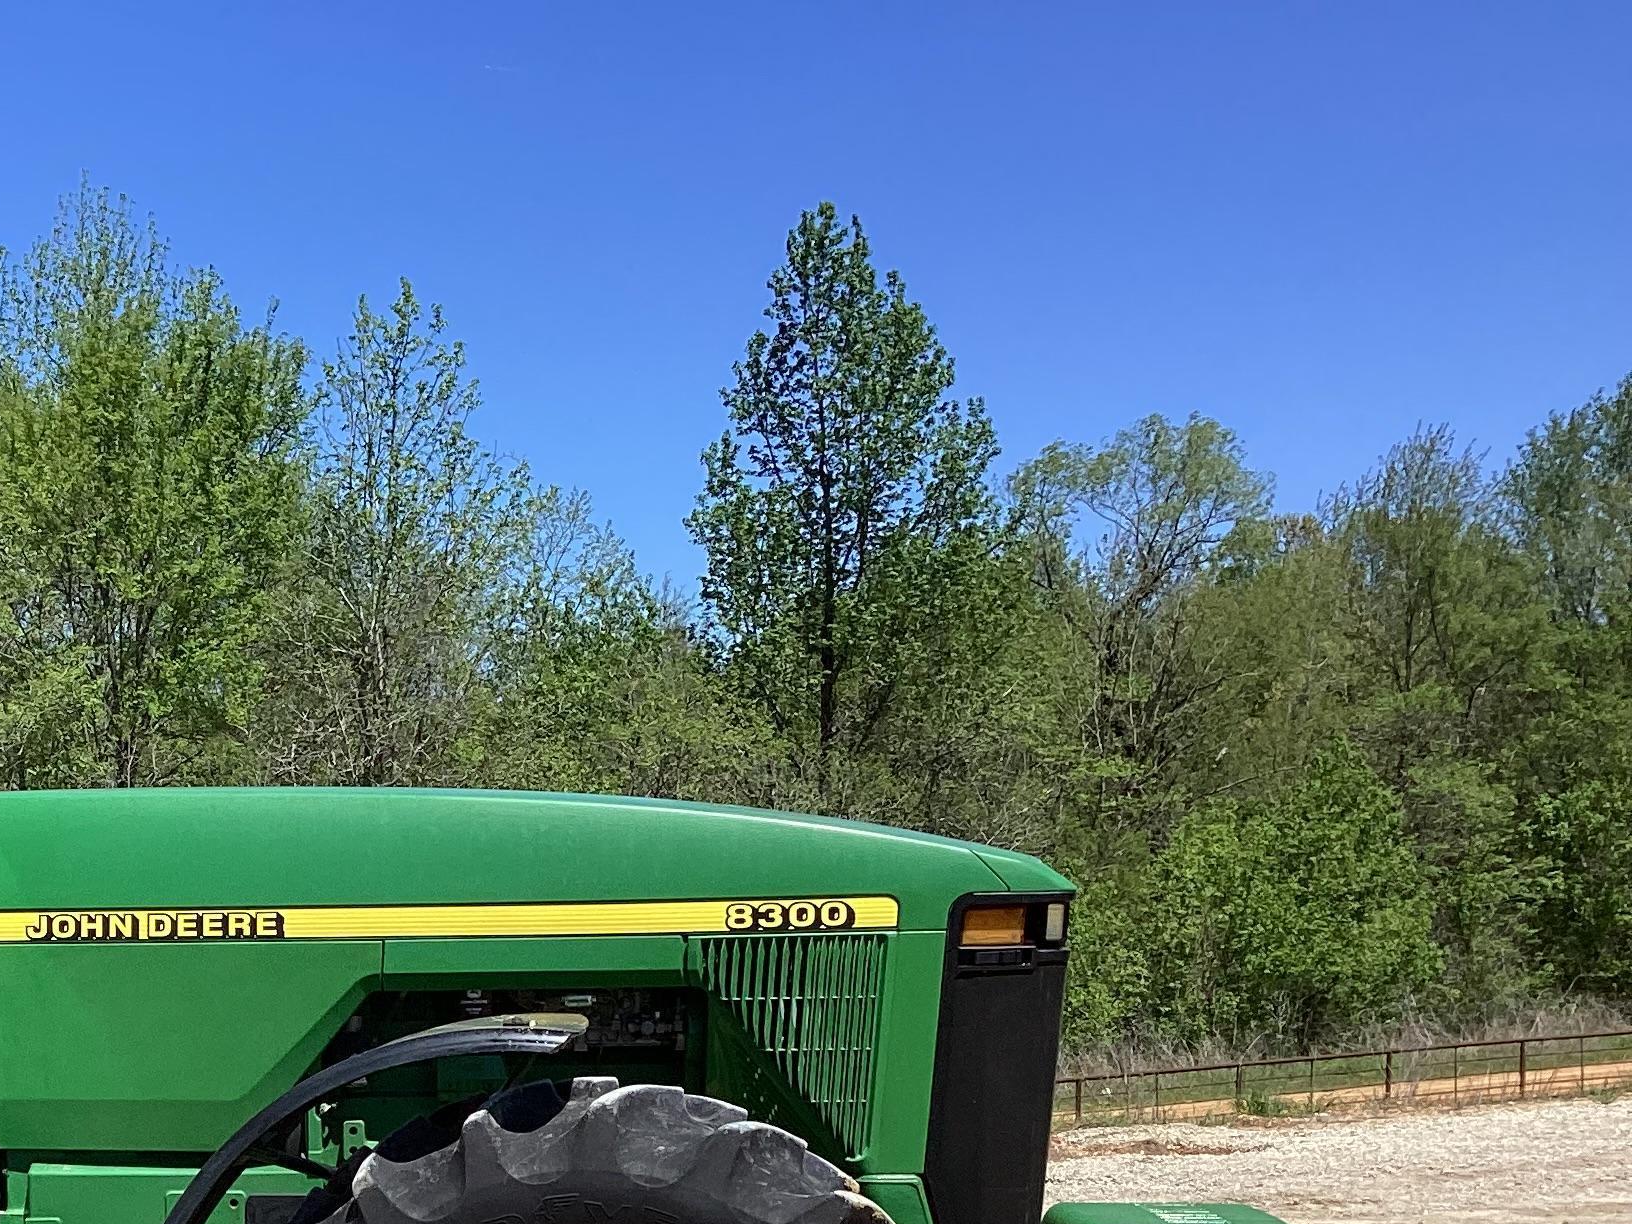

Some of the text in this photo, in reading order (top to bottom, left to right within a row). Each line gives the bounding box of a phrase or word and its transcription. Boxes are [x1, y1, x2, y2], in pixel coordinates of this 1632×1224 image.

[25, 911, 285, 941] JOHN DEERE
[726, 901, 856, 932] 8300
